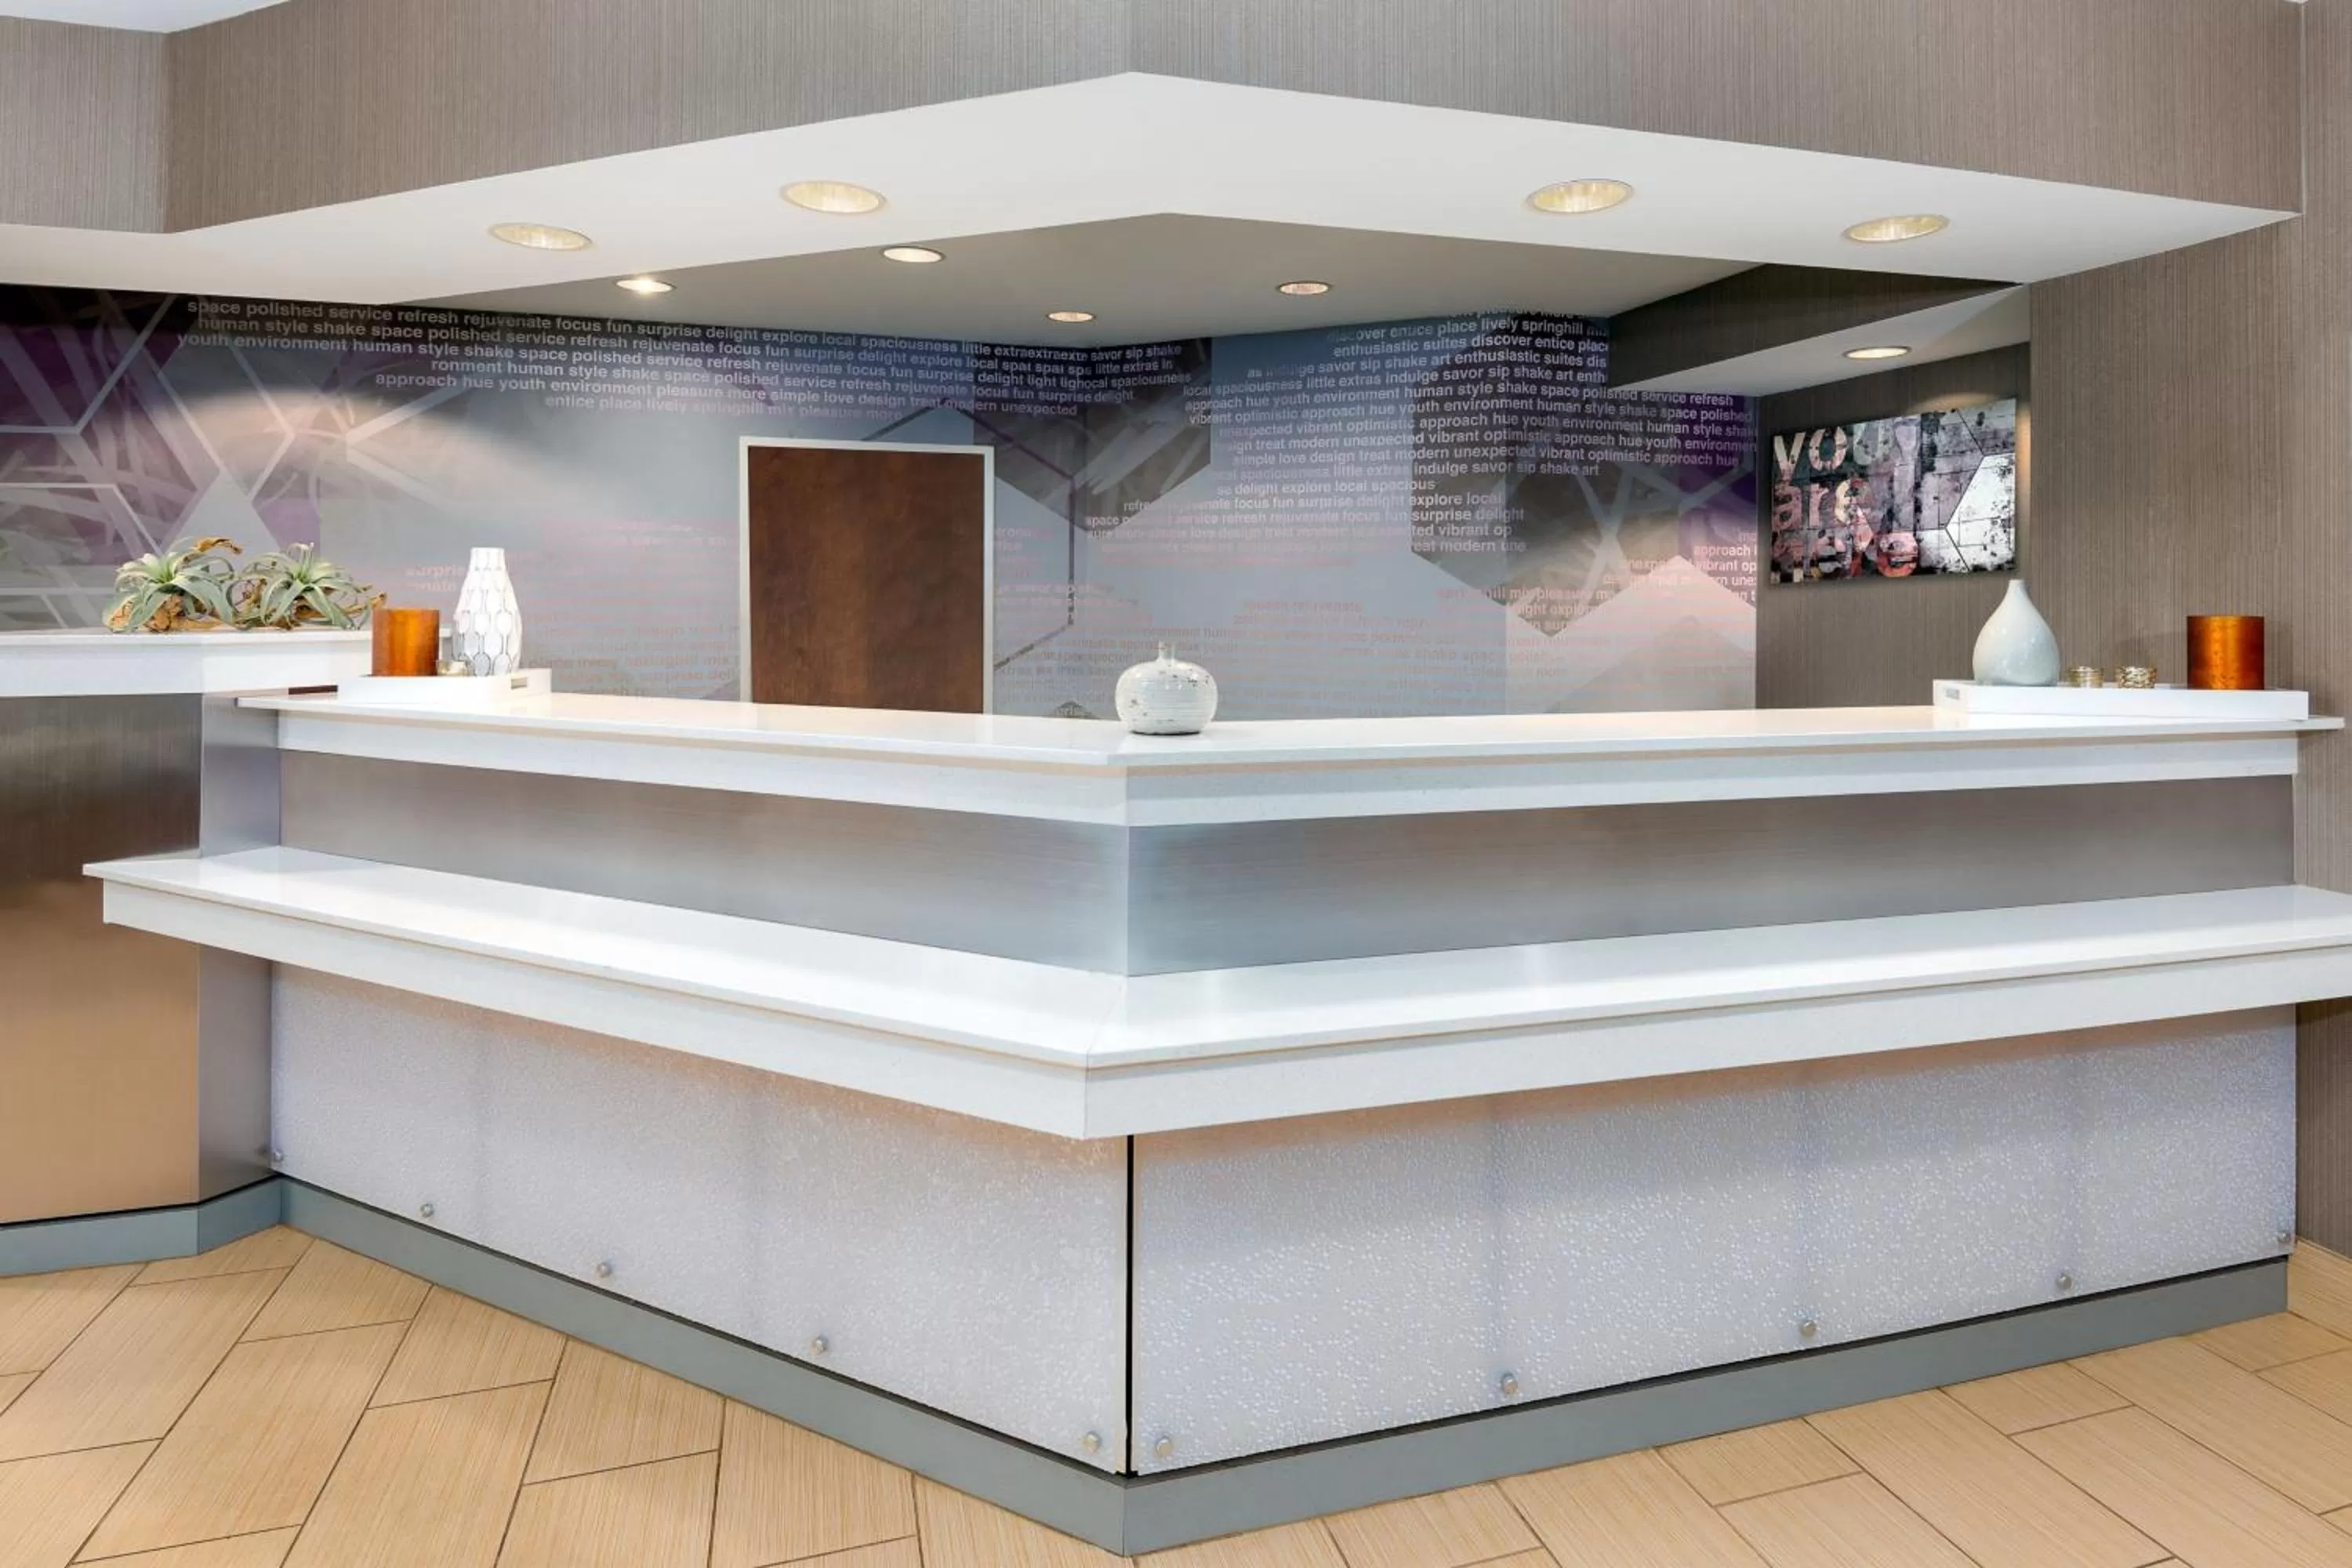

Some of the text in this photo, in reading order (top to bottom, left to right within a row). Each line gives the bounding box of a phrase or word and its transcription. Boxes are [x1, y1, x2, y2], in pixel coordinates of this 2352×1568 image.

[188, 301, 991, 355] space polished service refresh rejuvenate focus fun surprise delight explore local spaciousness little
[1438, 322, 1477, 337] place
[1482, 317, 1519, 332] lively
[1522, 320, 1583, 336] springhill
[198, 319, 997, 370] human style shake space polished service refresh rejuvenate focus fun surprise delight explore local
[1091, 347, 1143, 361] savor sip
[1333, 340, 1418, 358] enthusiastic
[1423, 337, 1466, 351] suites
[1472, 334, 1532, 348] discover
[1535, 337, 1574, 350] entice
[178, 333, 1192, 390] youth environment human style shake space polished service refresh rejuvenate focus fun surprise delight spaciousness
[1096, 360, 1159, 374] little extras
[1317, 350, 1583, 373] savor sip shake art enthusiastic suites
[432, 361, 1091, 403] ronment human style shake space polished service refresh rejuvenate focus fun surprise
[1184, 365, 1573, 397] local spaciousness little extras indulge savor sip shake art
[376, 374, 1078, 416] approach hue youth environment simple love design unexpected
[647, 398, 686, 413] lively
[1185, 381, 1733, 412] approach hue youth environment human style shake space polished refresh
[1189, 397, 1754, 425] vibrant optimistic approach hue youth environment human style space polished
[1297, 421, 1342, 434] vibrant
[1346, 417, 1414, 433] optimistic
[1420, 414, 1487, 430] approach
[1493, 411, 1518, 426] hue
[1523, 416, 1559, 430] youth
[1563, 417, 1643, 431] environment
[1647, 421, 1690, 434] human
[1693, 424, 1722, 438] style
[1256, 437, 1285, 449] treat
[1288, 436, 1339, 449] modern
[1344, 433, 1424, 448] unexpected
[1429, 431, 1479, 445] vibrant
[1483, 430, 1549, 444] optimistic
[1554, 434, 1614, 448] approach
[1618, 435, 1643, 448] hue
[1646, 437, 1681, 453] youth
[1279, 445, 1739, 466] love design treat modern unexpected vibrant optimistic approach hue
[1414, 461, 1535, 477] indulge savor sip
[1236, 481, 1278, 496] delight
[1283, 481, 1331, 495] explore
[1335, 479, 1367, 492] local
[1372, 479, 1436, 493] spacious
[1235, 497, 1270, 510] focus
[1273, 497, 1295, 508] fun
[1298, 495, 1355, 510] surprise
[1410, 492, 1461, 506] explore
[1412, 510, 1471, 523] surprise
[1439, 525, 1489, 536] vibrant
[1439, 542, 1496, 553] modern
